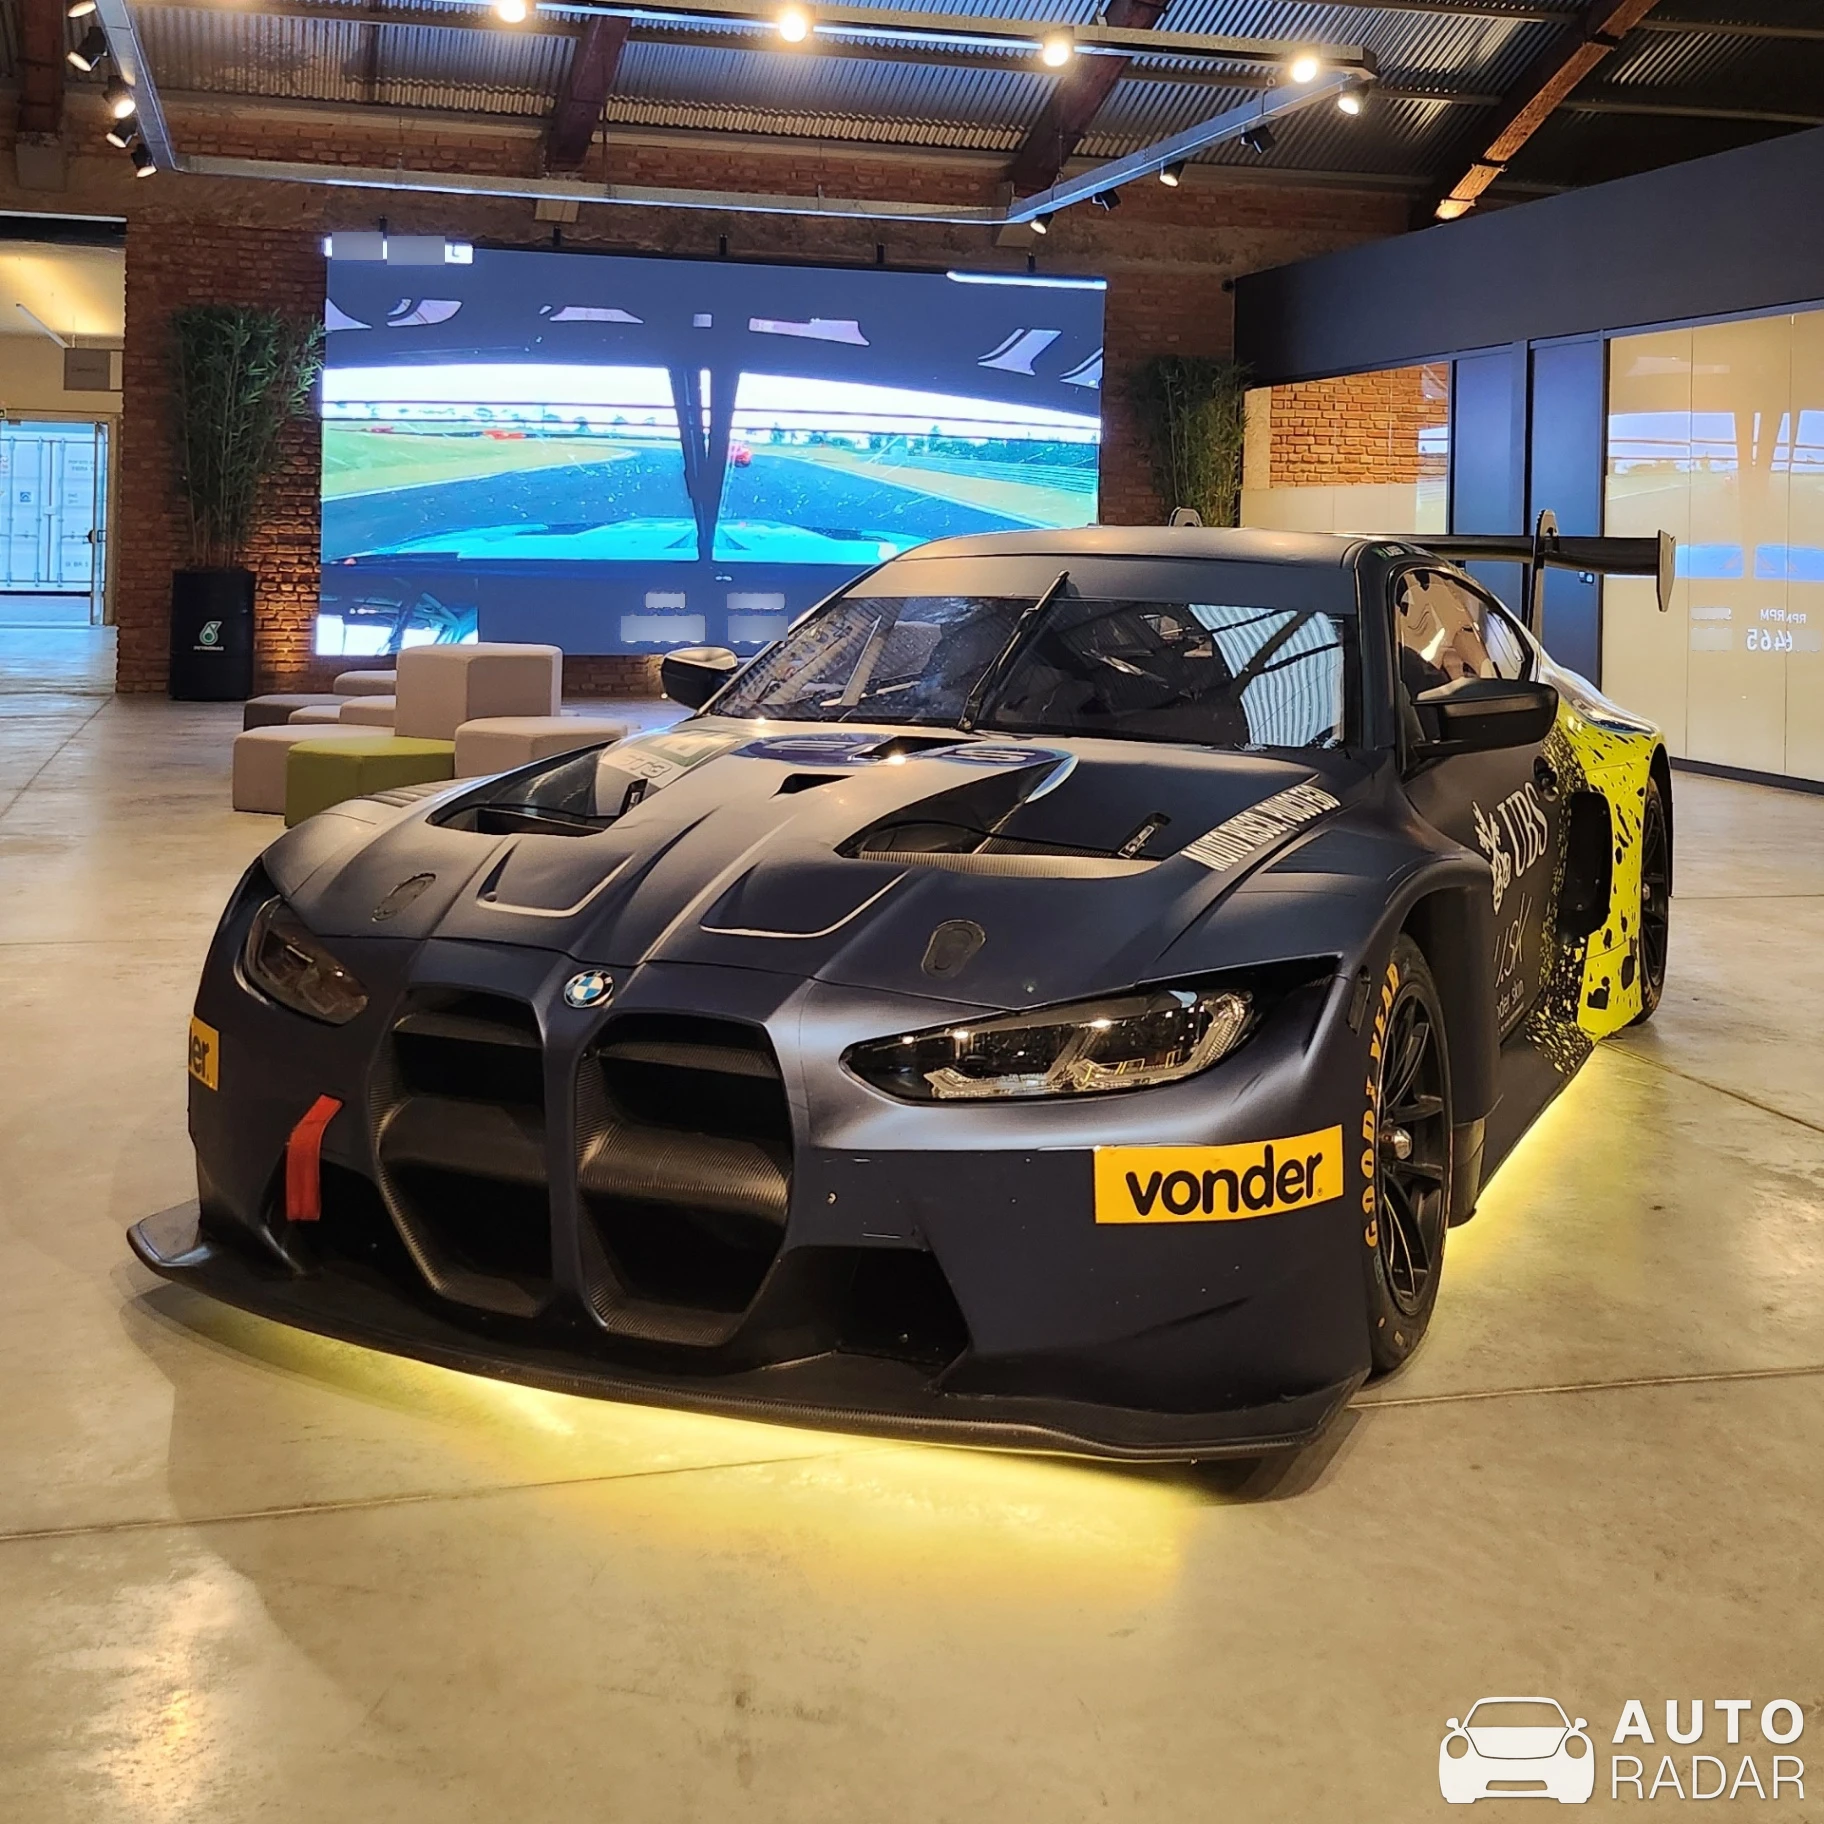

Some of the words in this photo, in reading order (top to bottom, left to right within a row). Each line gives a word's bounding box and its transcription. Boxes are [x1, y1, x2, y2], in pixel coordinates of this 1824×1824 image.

[1180, 830, 1255, 872] MUITO
[1496, 781, 1548, 877] UBS
[190, 1034, 210, 1079] er
[1125, 1144, 1323, 1216] vonder
